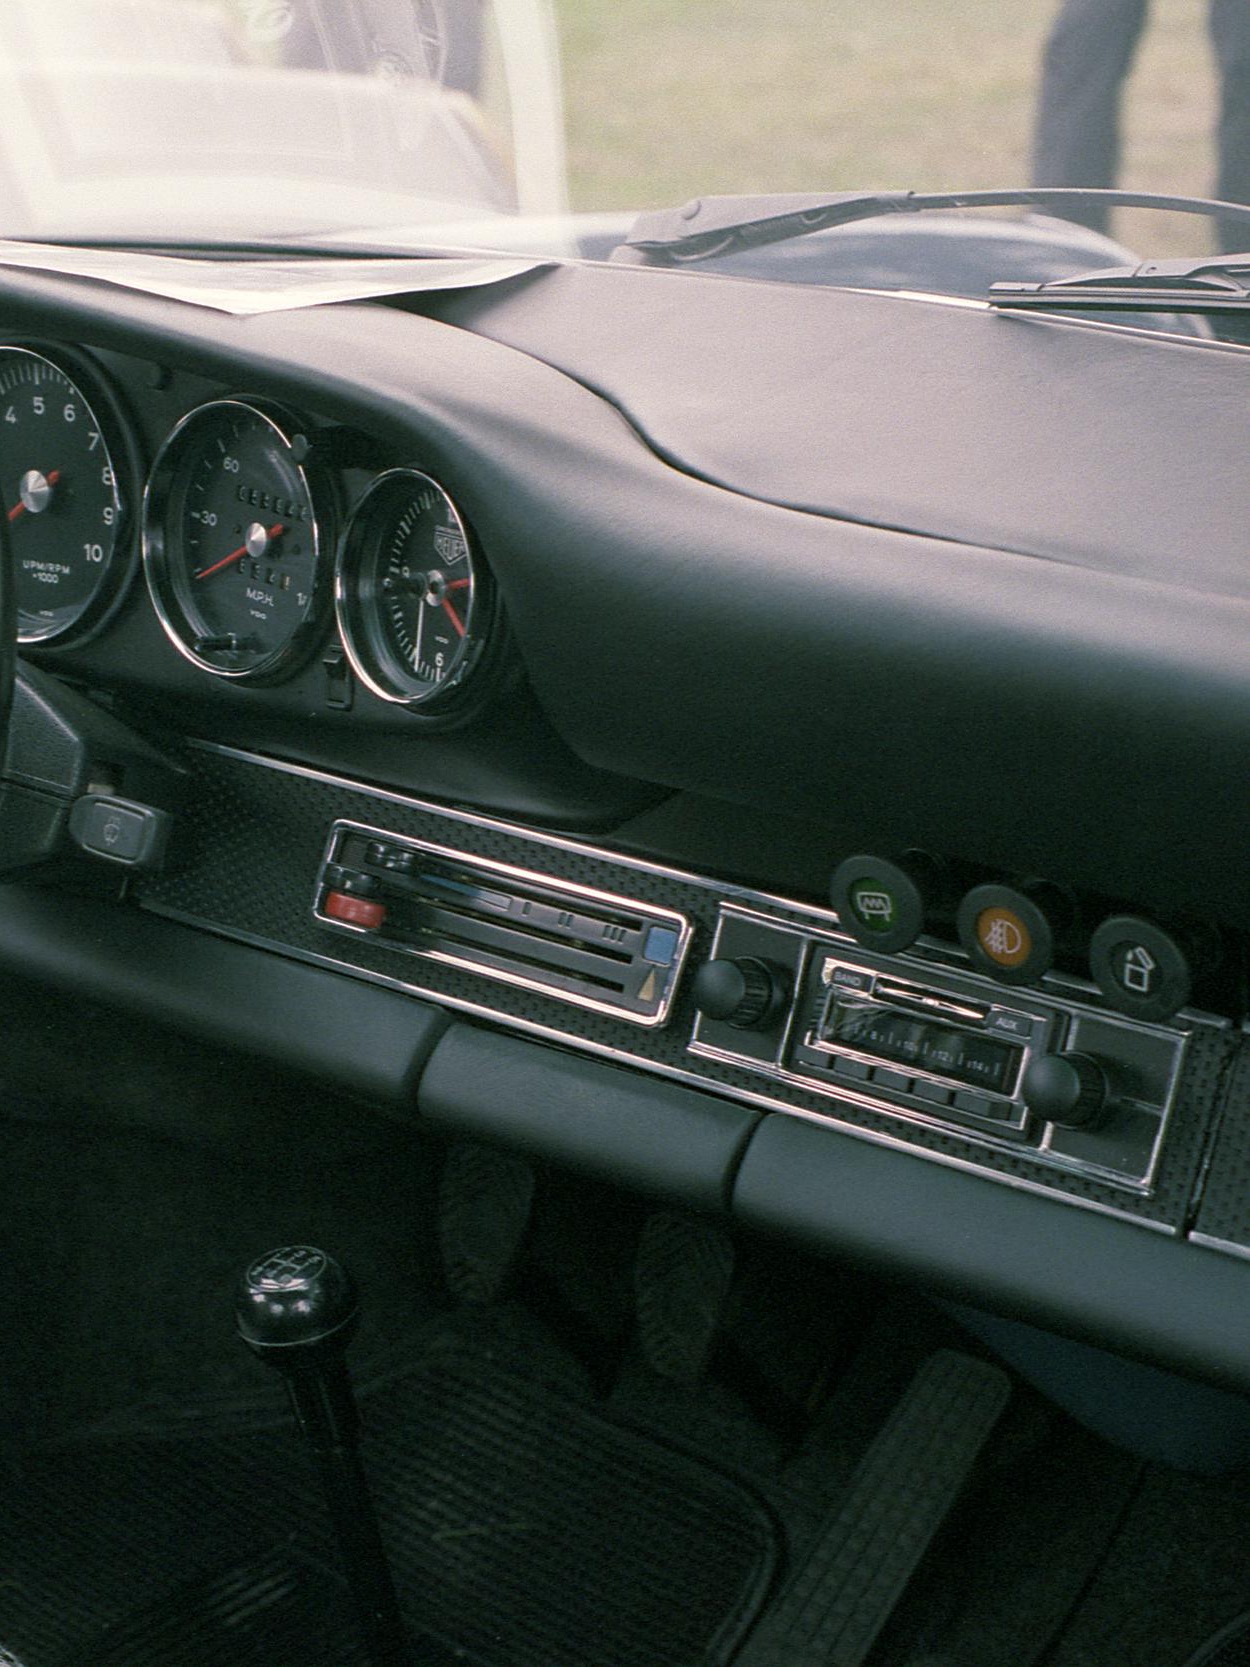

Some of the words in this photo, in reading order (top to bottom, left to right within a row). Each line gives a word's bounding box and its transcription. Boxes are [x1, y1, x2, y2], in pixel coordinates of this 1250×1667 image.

[5, 405, 17, 424] 4
[33, 396, 45, 415] 5
[63, 403, 76, 422] 6
[88, 432, 99, 451] 7
[223, 456, 239, 473] 60
[102, 466, 113, 485] 8
[103, 507, 114, 525] 9
[200, 510, 217, 527] 30
[83, 543, 103, 562] 10
[22, 560, 70, 575] UPM/RPM
[435, 652, 444, 667] 6
